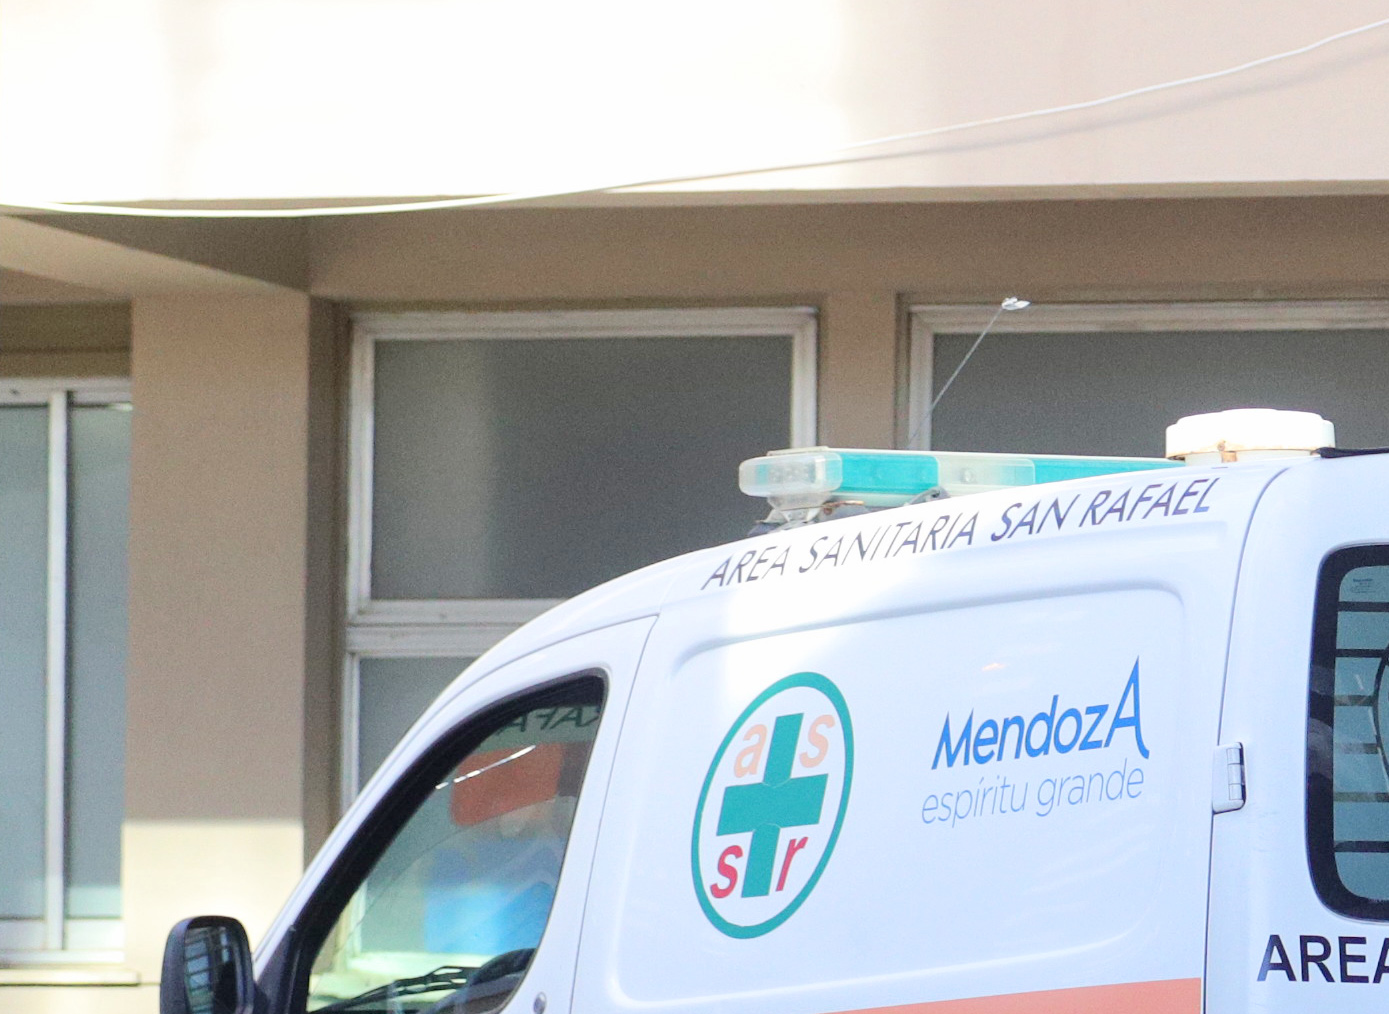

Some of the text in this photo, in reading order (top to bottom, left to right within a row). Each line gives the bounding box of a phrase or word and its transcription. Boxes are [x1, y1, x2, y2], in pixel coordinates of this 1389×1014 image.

[700, 477, 1220, 590] AREA SANITARIA SAN RAFAEL
[921, 758, 1144, 828] espíritu grande
